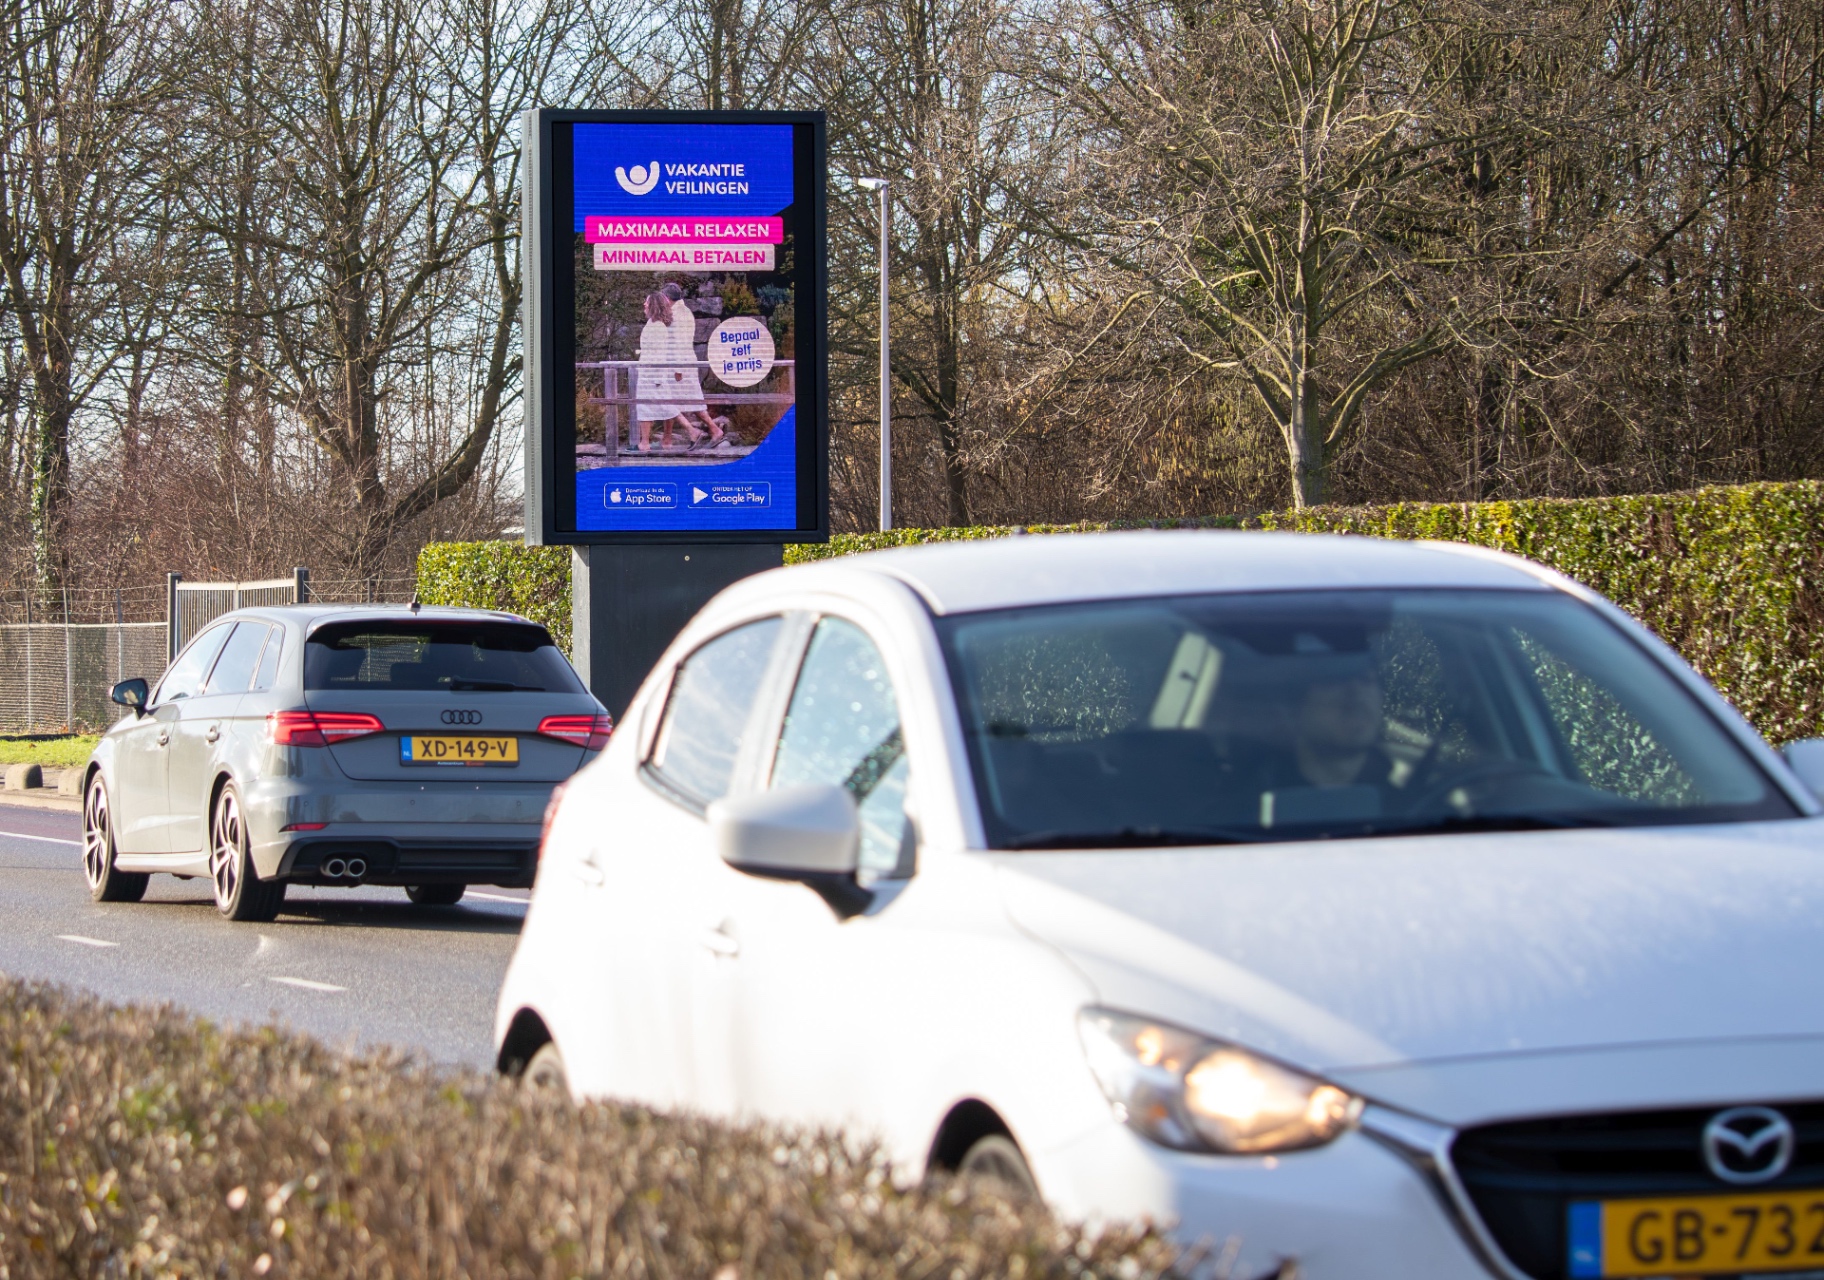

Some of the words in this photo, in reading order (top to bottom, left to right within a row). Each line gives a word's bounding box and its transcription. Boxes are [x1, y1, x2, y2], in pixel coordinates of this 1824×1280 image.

[665, 163, 745, 177] VAKANTIE
[665, 181, 749, 195] VEILINGEN
[598, 223, 691, 238] MAXIMAAL
[694, 223, 770, 238] RELAXEN
[602, 250, 690, 264] MINIMAAL
[693, 250, 766, 264] BETALEN
[720, 328, 760, 344] Bepaal
[731, 343, 751, 357] zelf
[722, 360, 734, 375] je
[736, 358, 762, 374] prijs
[625, 494, 645, 505] App
[646, 493, 672, 503] Store
[712, 493, 745, 505] Google
[746, 492, 766, 505] Play
[421, 740, 508, 758] XD-149-V
